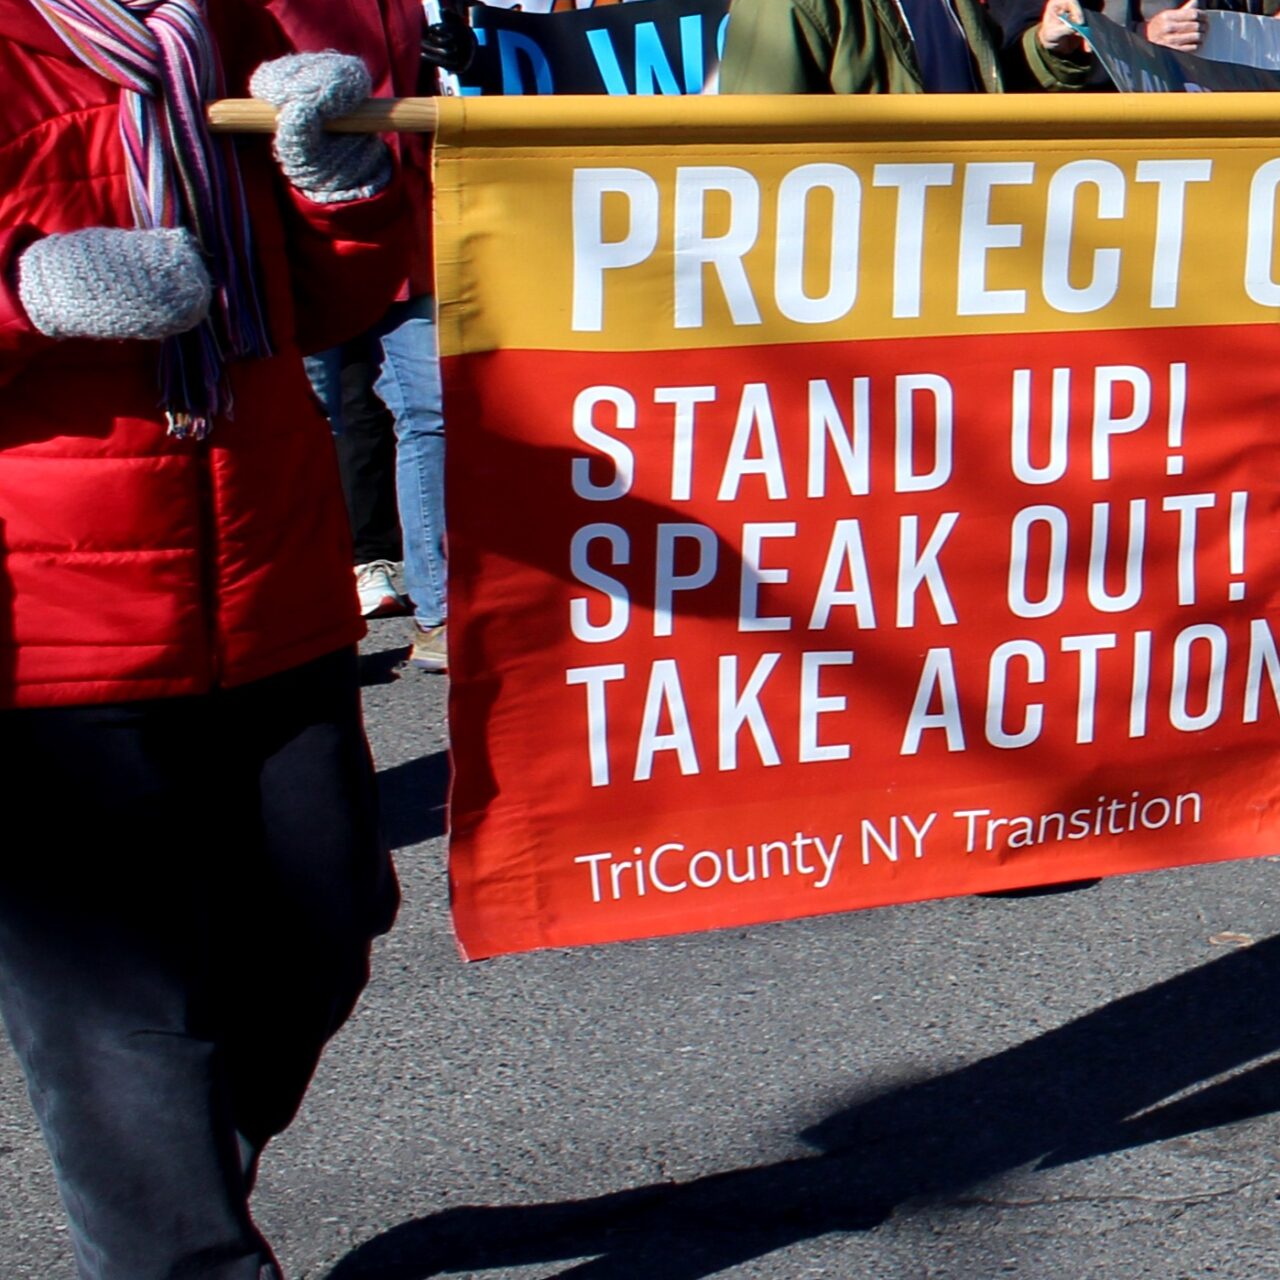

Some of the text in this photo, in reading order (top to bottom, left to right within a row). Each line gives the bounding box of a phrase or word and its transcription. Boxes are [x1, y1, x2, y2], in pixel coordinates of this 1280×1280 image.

[572, 159, 1213, 332] PROTECT
[571, 362, 1187, 502] STAND UP!
[569, 491, 1248, 643] SPEAK OUT!
[566, 650, 855, 788] TAKE
[574, 789, 1202, 903] TriCounty NY Transition
